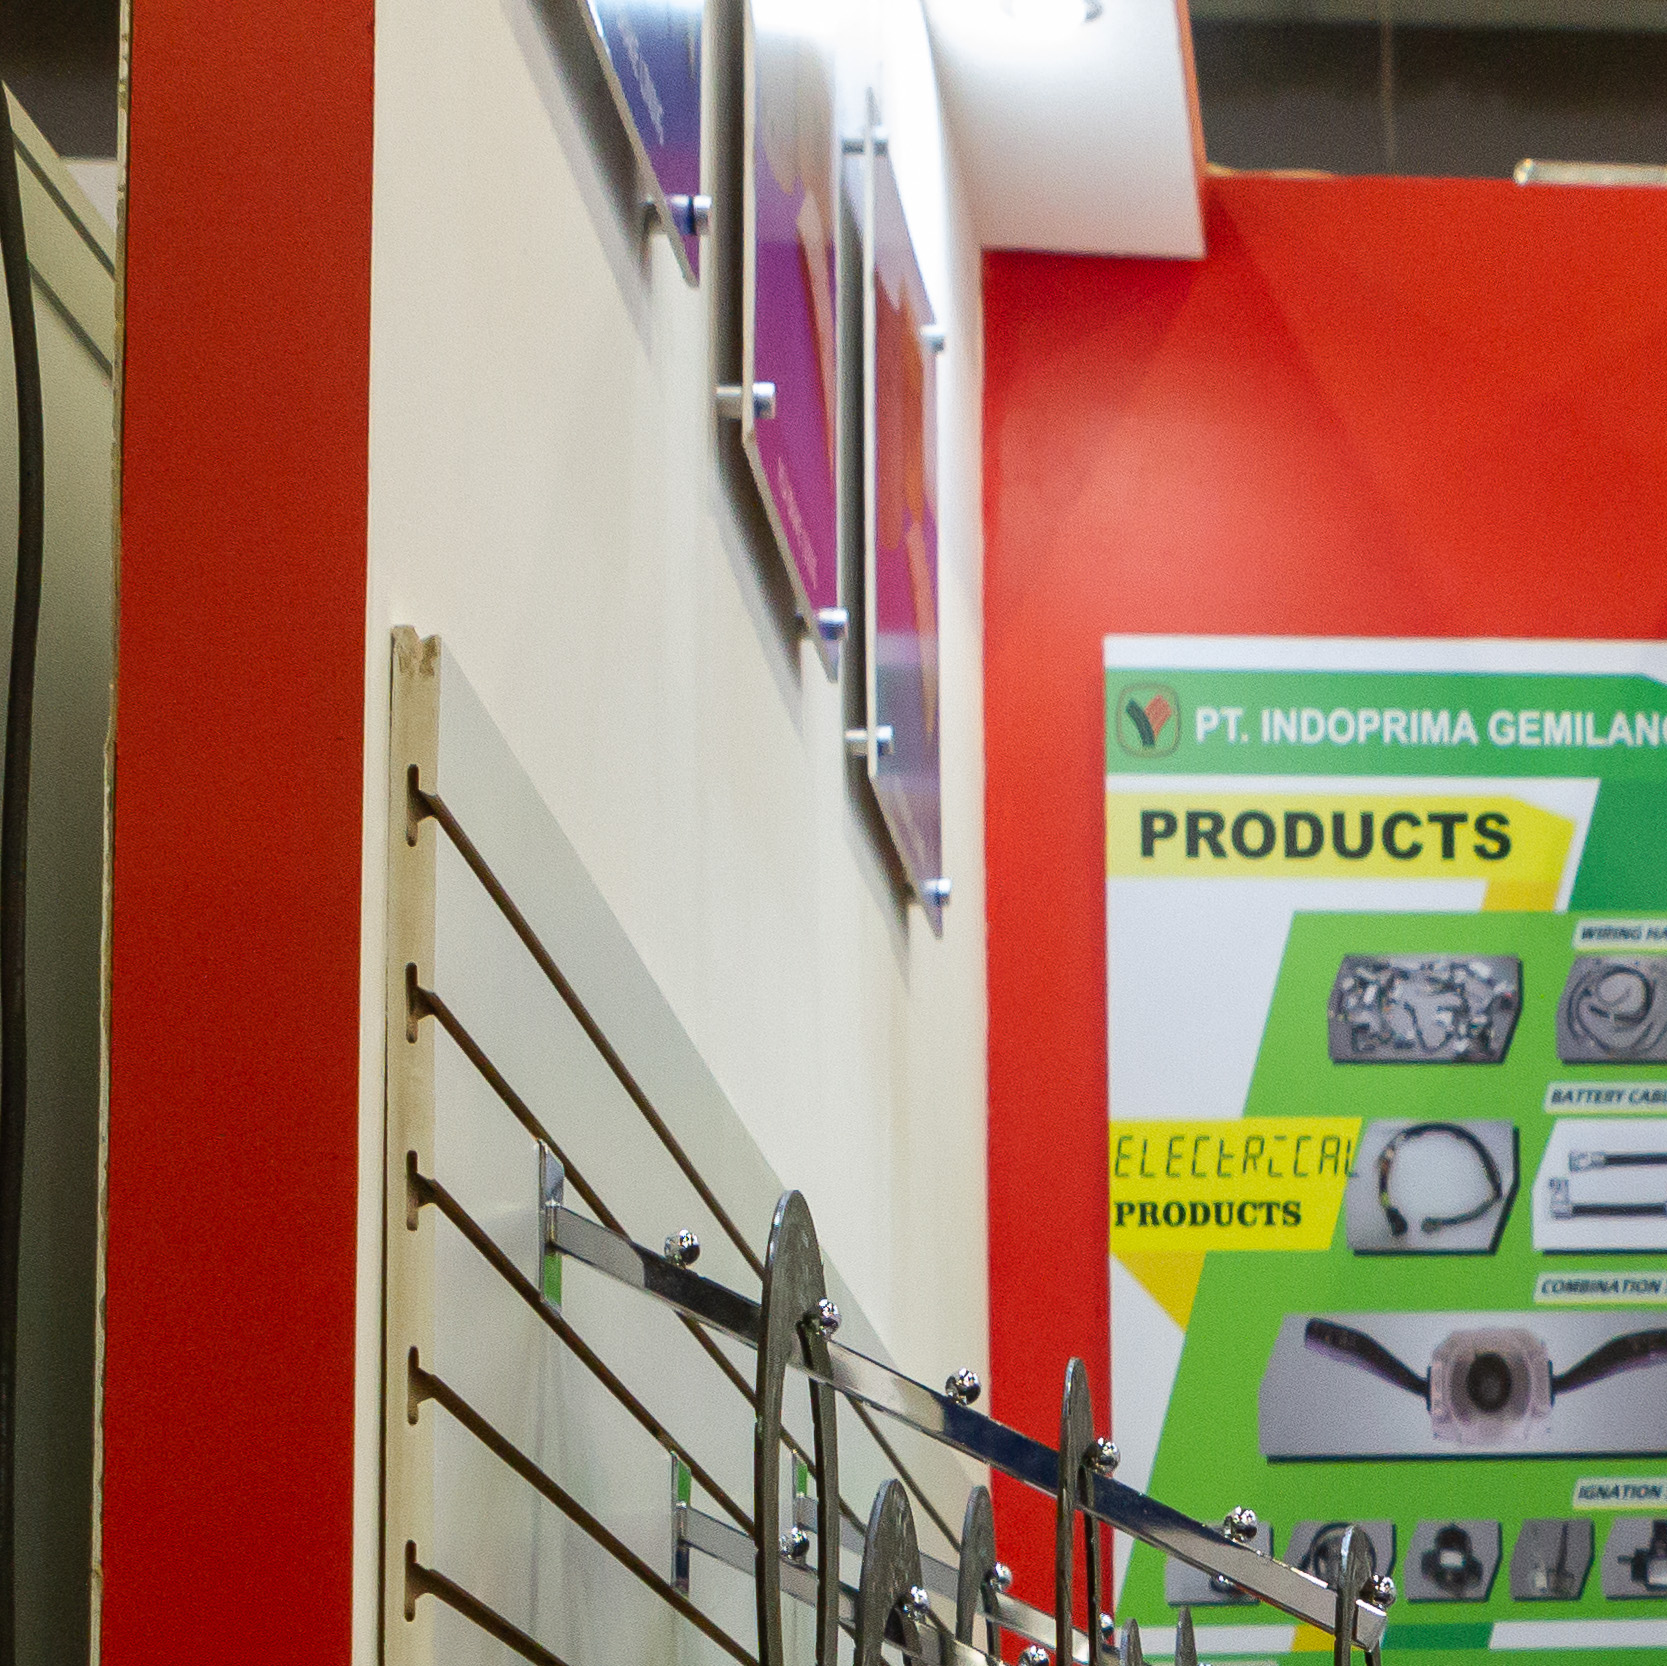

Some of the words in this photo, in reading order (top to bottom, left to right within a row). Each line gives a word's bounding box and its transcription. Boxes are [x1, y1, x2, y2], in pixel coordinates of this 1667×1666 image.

[1195, 708, 1246, 743] PT.
[1261, 709, 1478, 745] INDOPRIMA
[1139, 809, 1513, 861] PRODUCTS
[1551, 1089, 1625, 1104] BATTERY
[1114, 1200, 1302, 1227] PRODUCTS
[1541, 1279, 1660, 1294] COMBINATION
[1577, 1483, 1663, 1499] IGNATION
